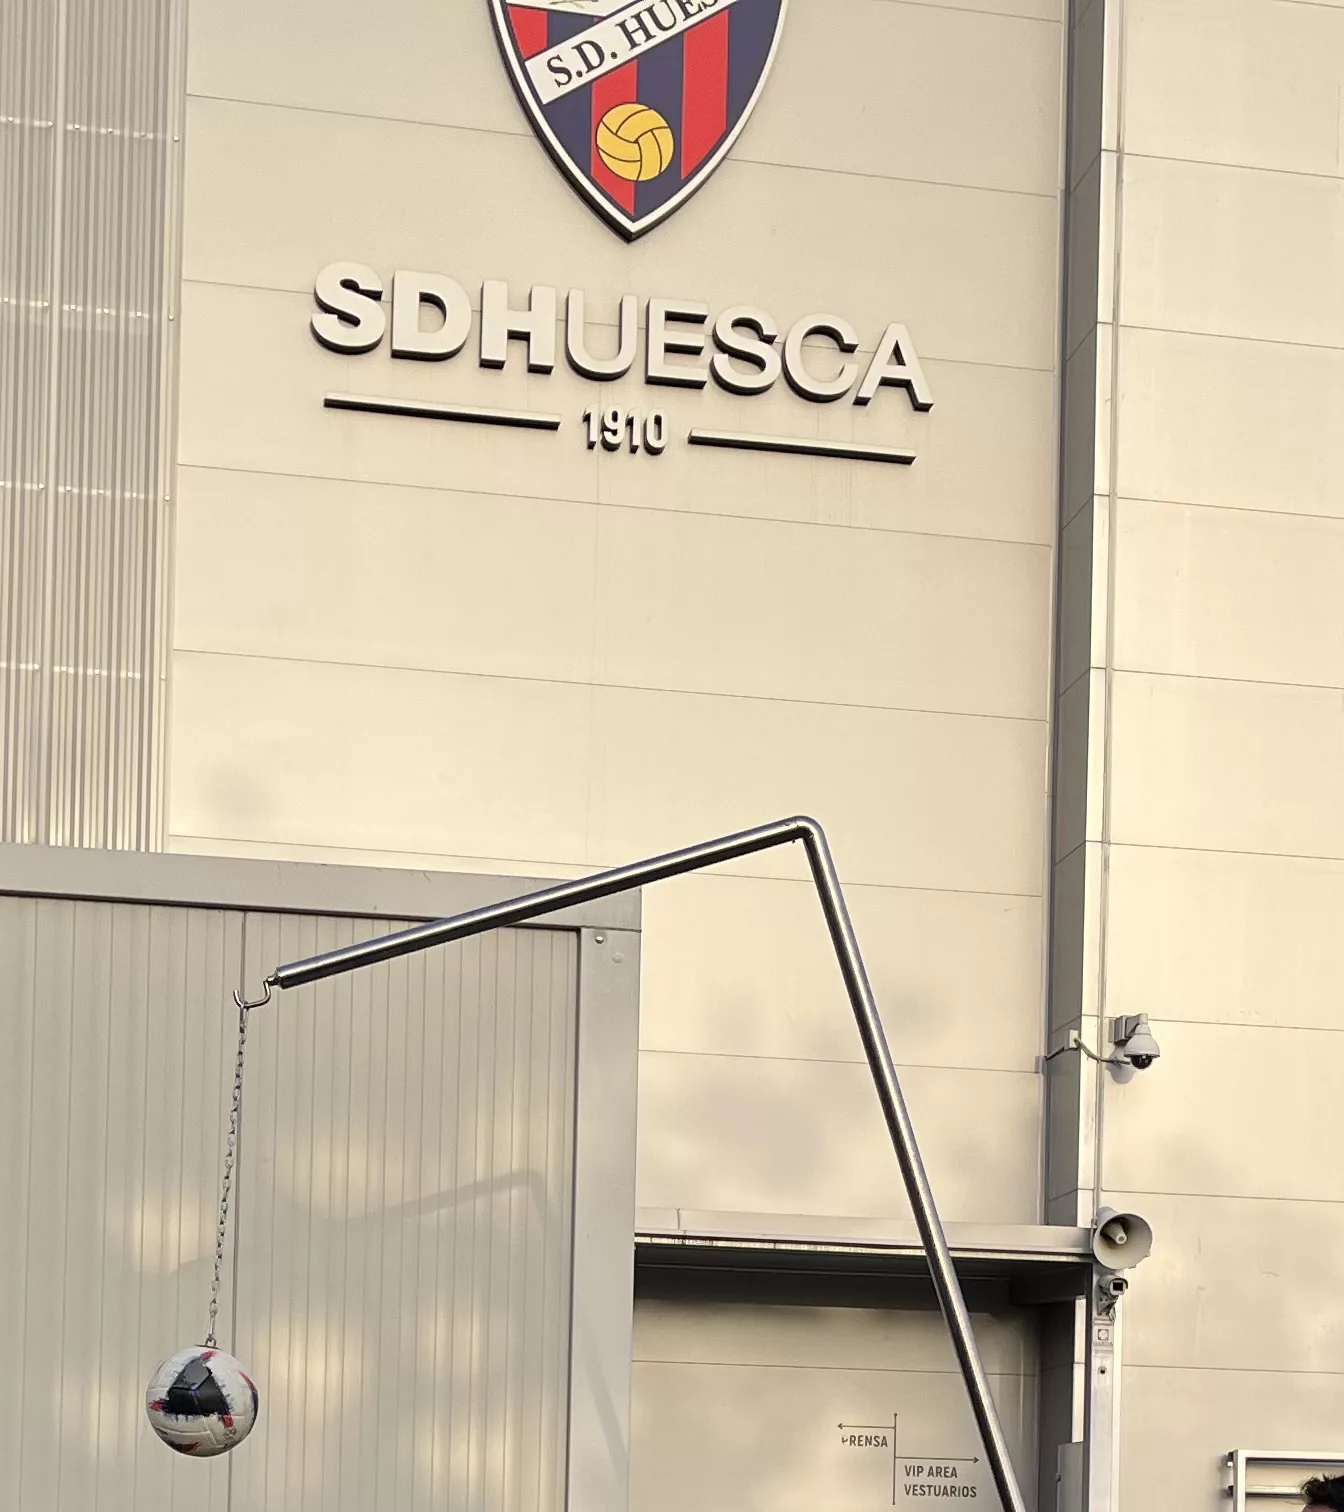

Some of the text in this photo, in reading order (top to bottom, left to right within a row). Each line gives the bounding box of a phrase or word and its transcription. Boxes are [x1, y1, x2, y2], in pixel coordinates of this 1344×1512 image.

[546, 38, 618, 88] S.D.
[311, 261, 934, 412] SDHUESCA
[582, 404, 669, 456] 1910
[903, 1483, 978, 1499] VESTUARIOS
[904, 1464, 959, 1479] VIP AREA
